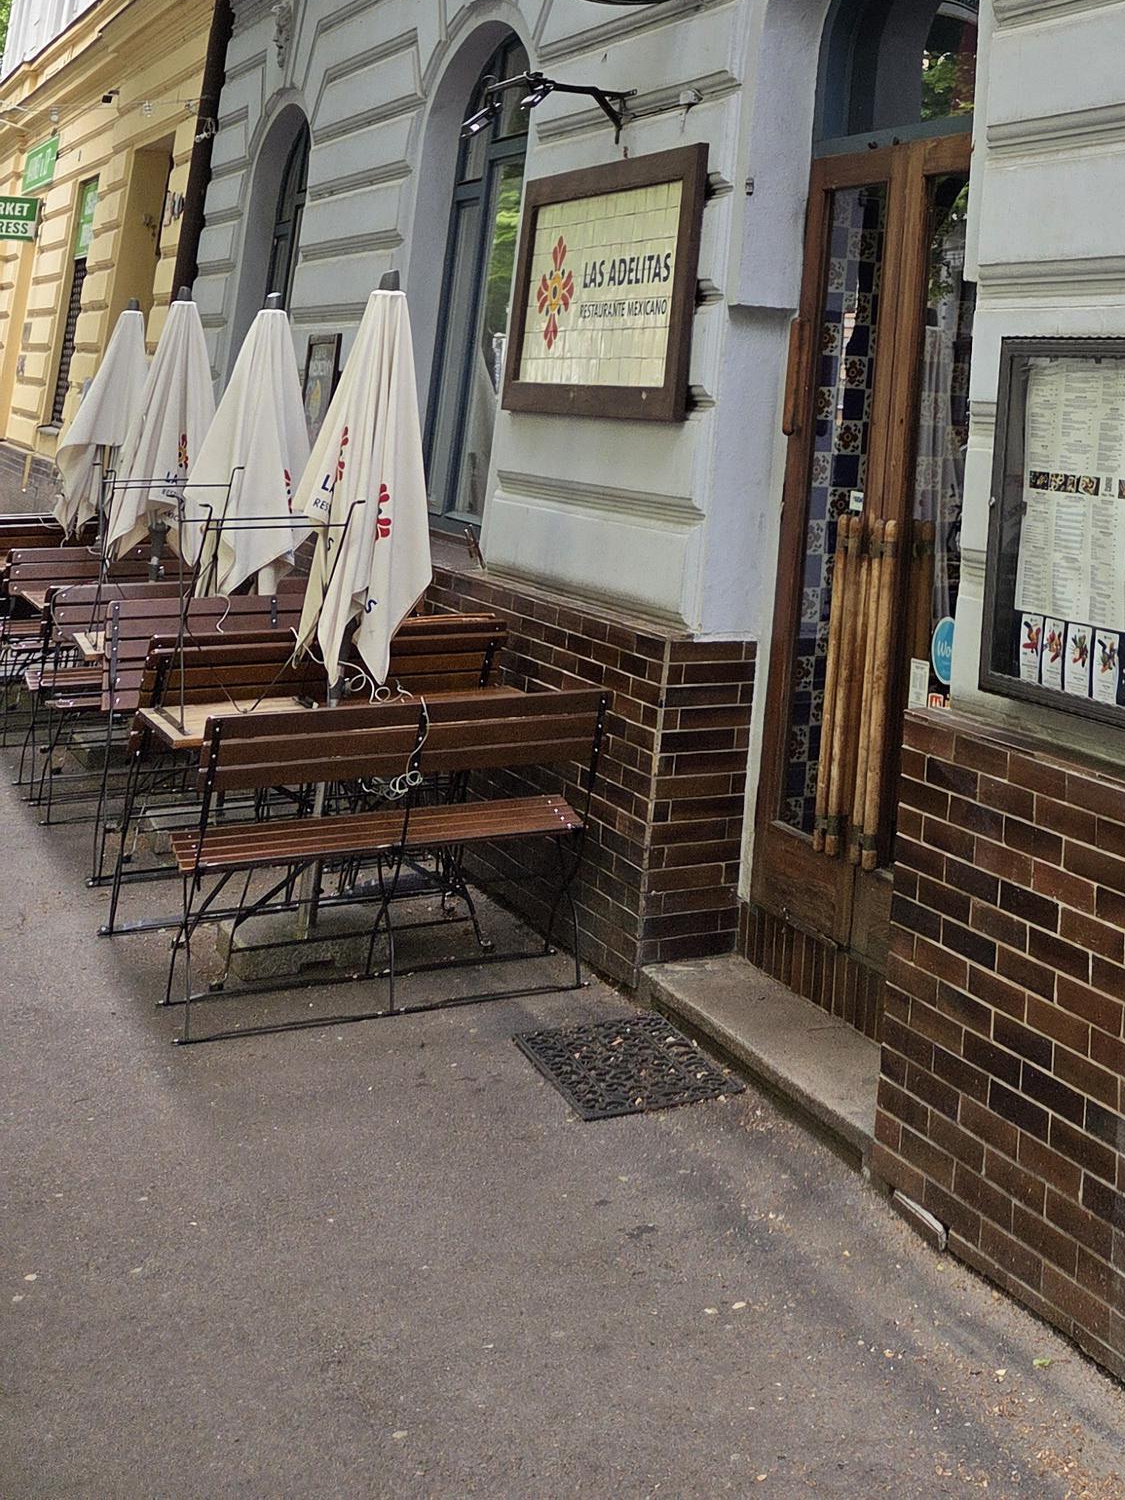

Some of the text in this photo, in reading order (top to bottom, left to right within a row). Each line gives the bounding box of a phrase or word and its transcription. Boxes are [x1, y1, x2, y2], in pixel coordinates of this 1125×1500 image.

[583, 252, 671, 288] LAS ADELITAS
[579, 299, 667, 319] RESTAURANTE MEXICANO
